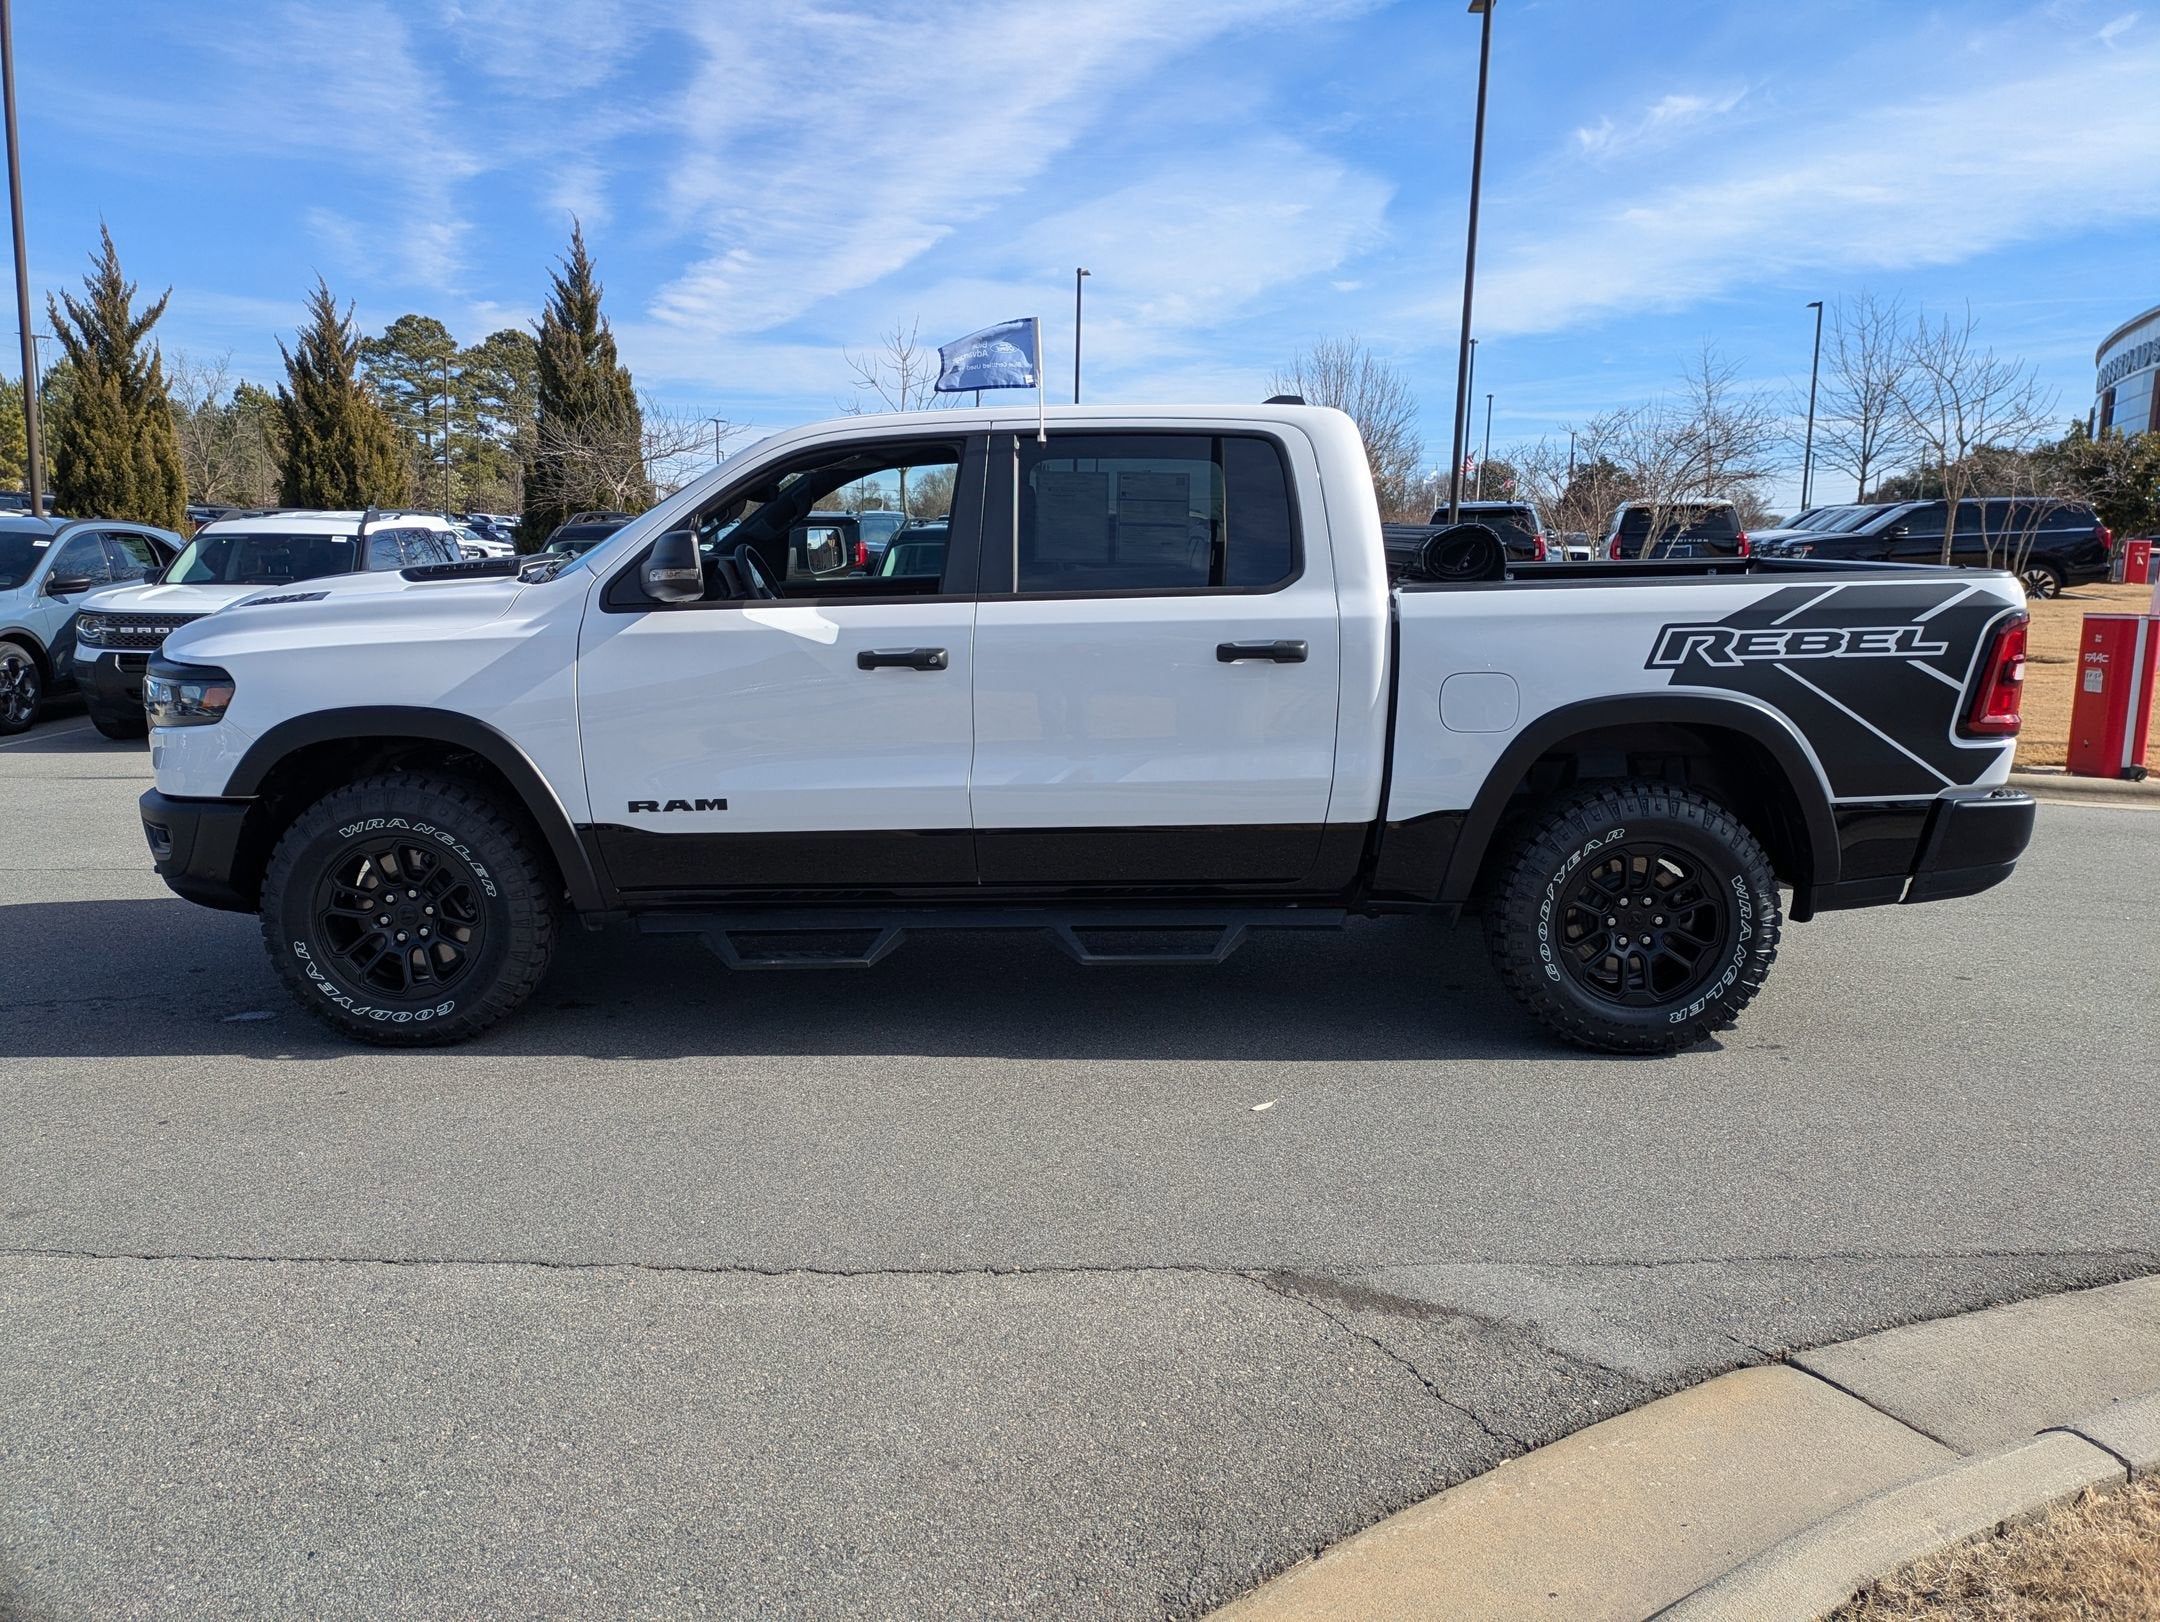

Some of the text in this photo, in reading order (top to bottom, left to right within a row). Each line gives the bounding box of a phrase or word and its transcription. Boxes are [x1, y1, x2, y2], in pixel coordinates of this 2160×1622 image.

[1650, 625, 1949, 668] REBEL
[2084, 652, 2110, 663] FAAC
[627, 798, 728, 813] RAM
[339, 818, 497, 897] WRANGLER
[1538, 828, 1625, 981] GOODYEAR
[294, 941, 455, 1022] GOODYEAR
[1669, 875, 1752, 1023] WRANGLER
